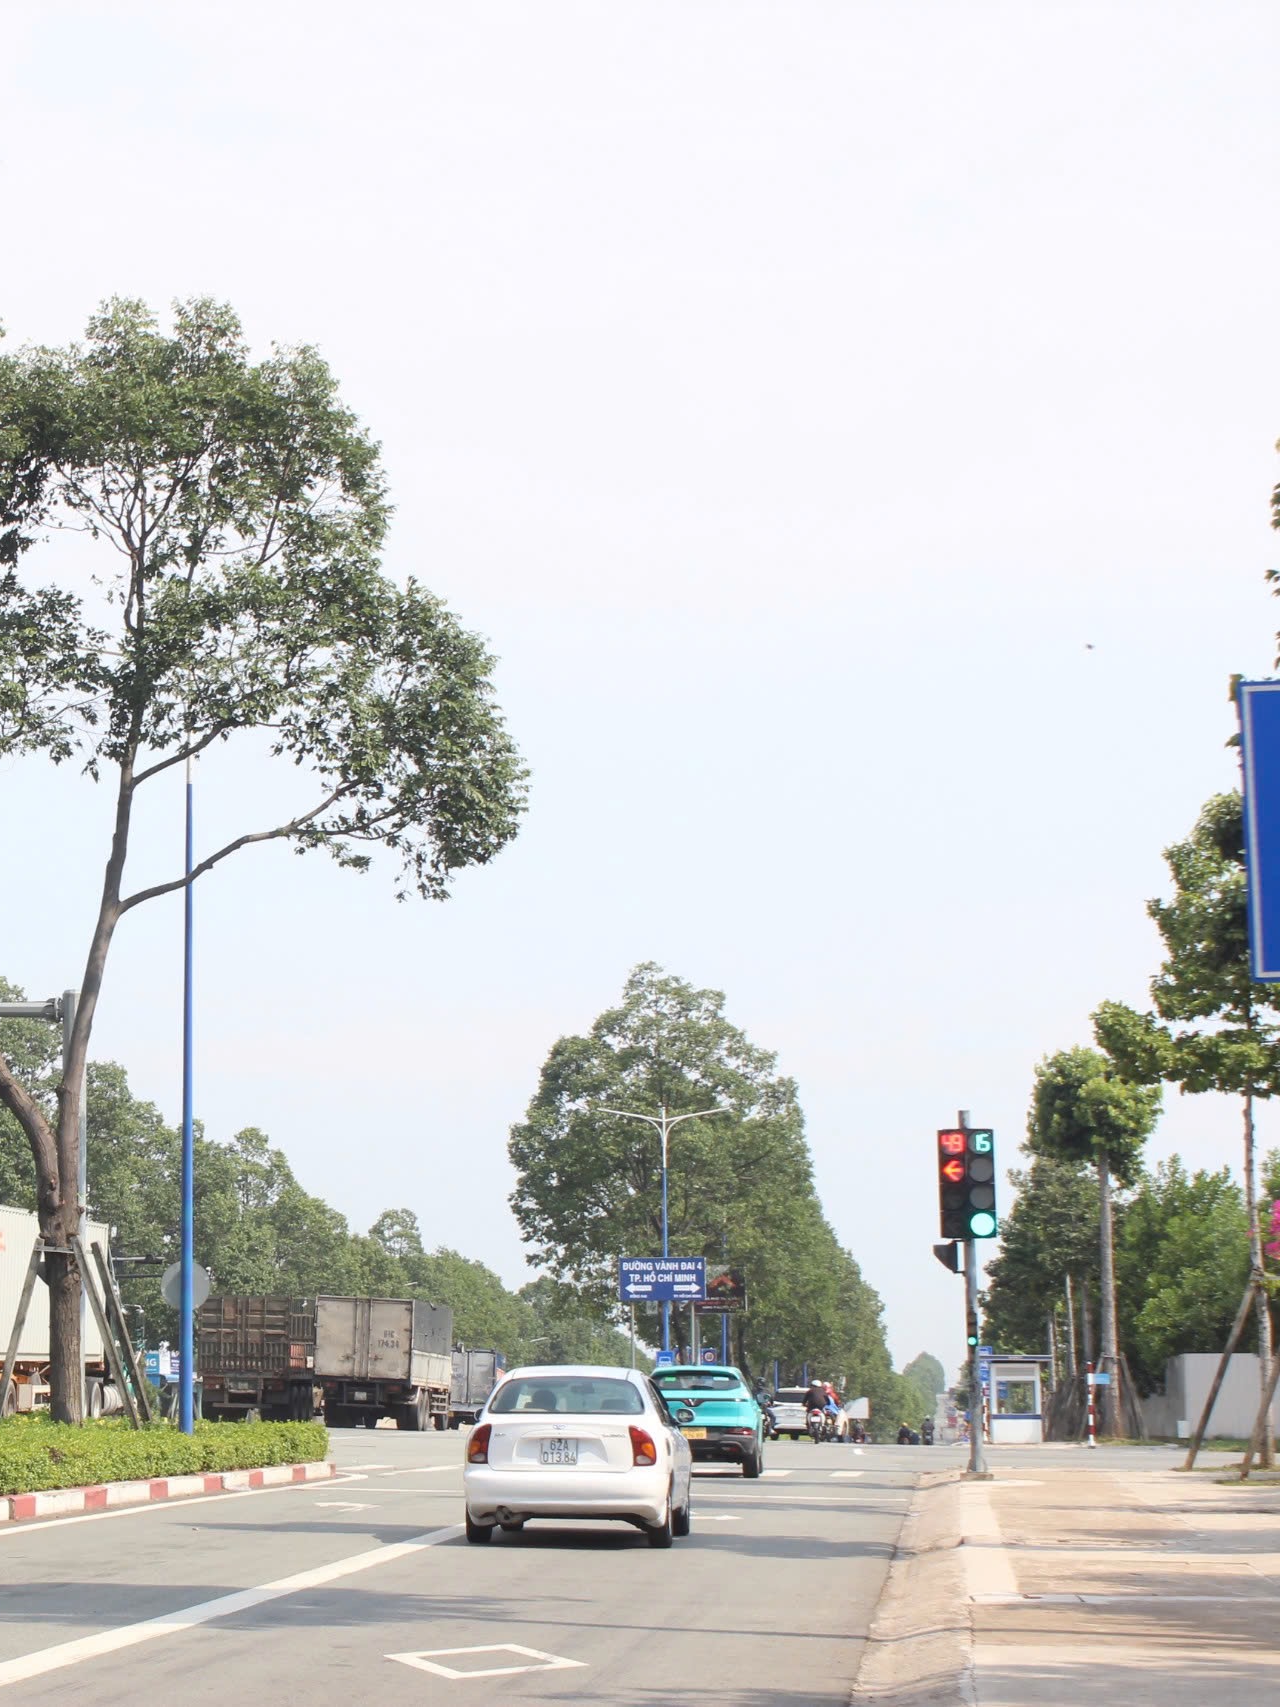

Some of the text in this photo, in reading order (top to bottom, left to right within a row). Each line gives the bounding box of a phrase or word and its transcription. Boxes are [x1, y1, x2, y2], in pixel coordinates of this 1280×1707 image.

[622, 1260, 702, 1271] ĐƯỜNG VÀNH ĐAI 4
[643, 1271, 656, 1283] HỒ
[657, 1271, 673, 1283] CHÍ
[674, 1273, 697, 1283] MINH
[549, 1440, 569, 1451] 62A
[542, 1451, 576, 1464] 013.84
